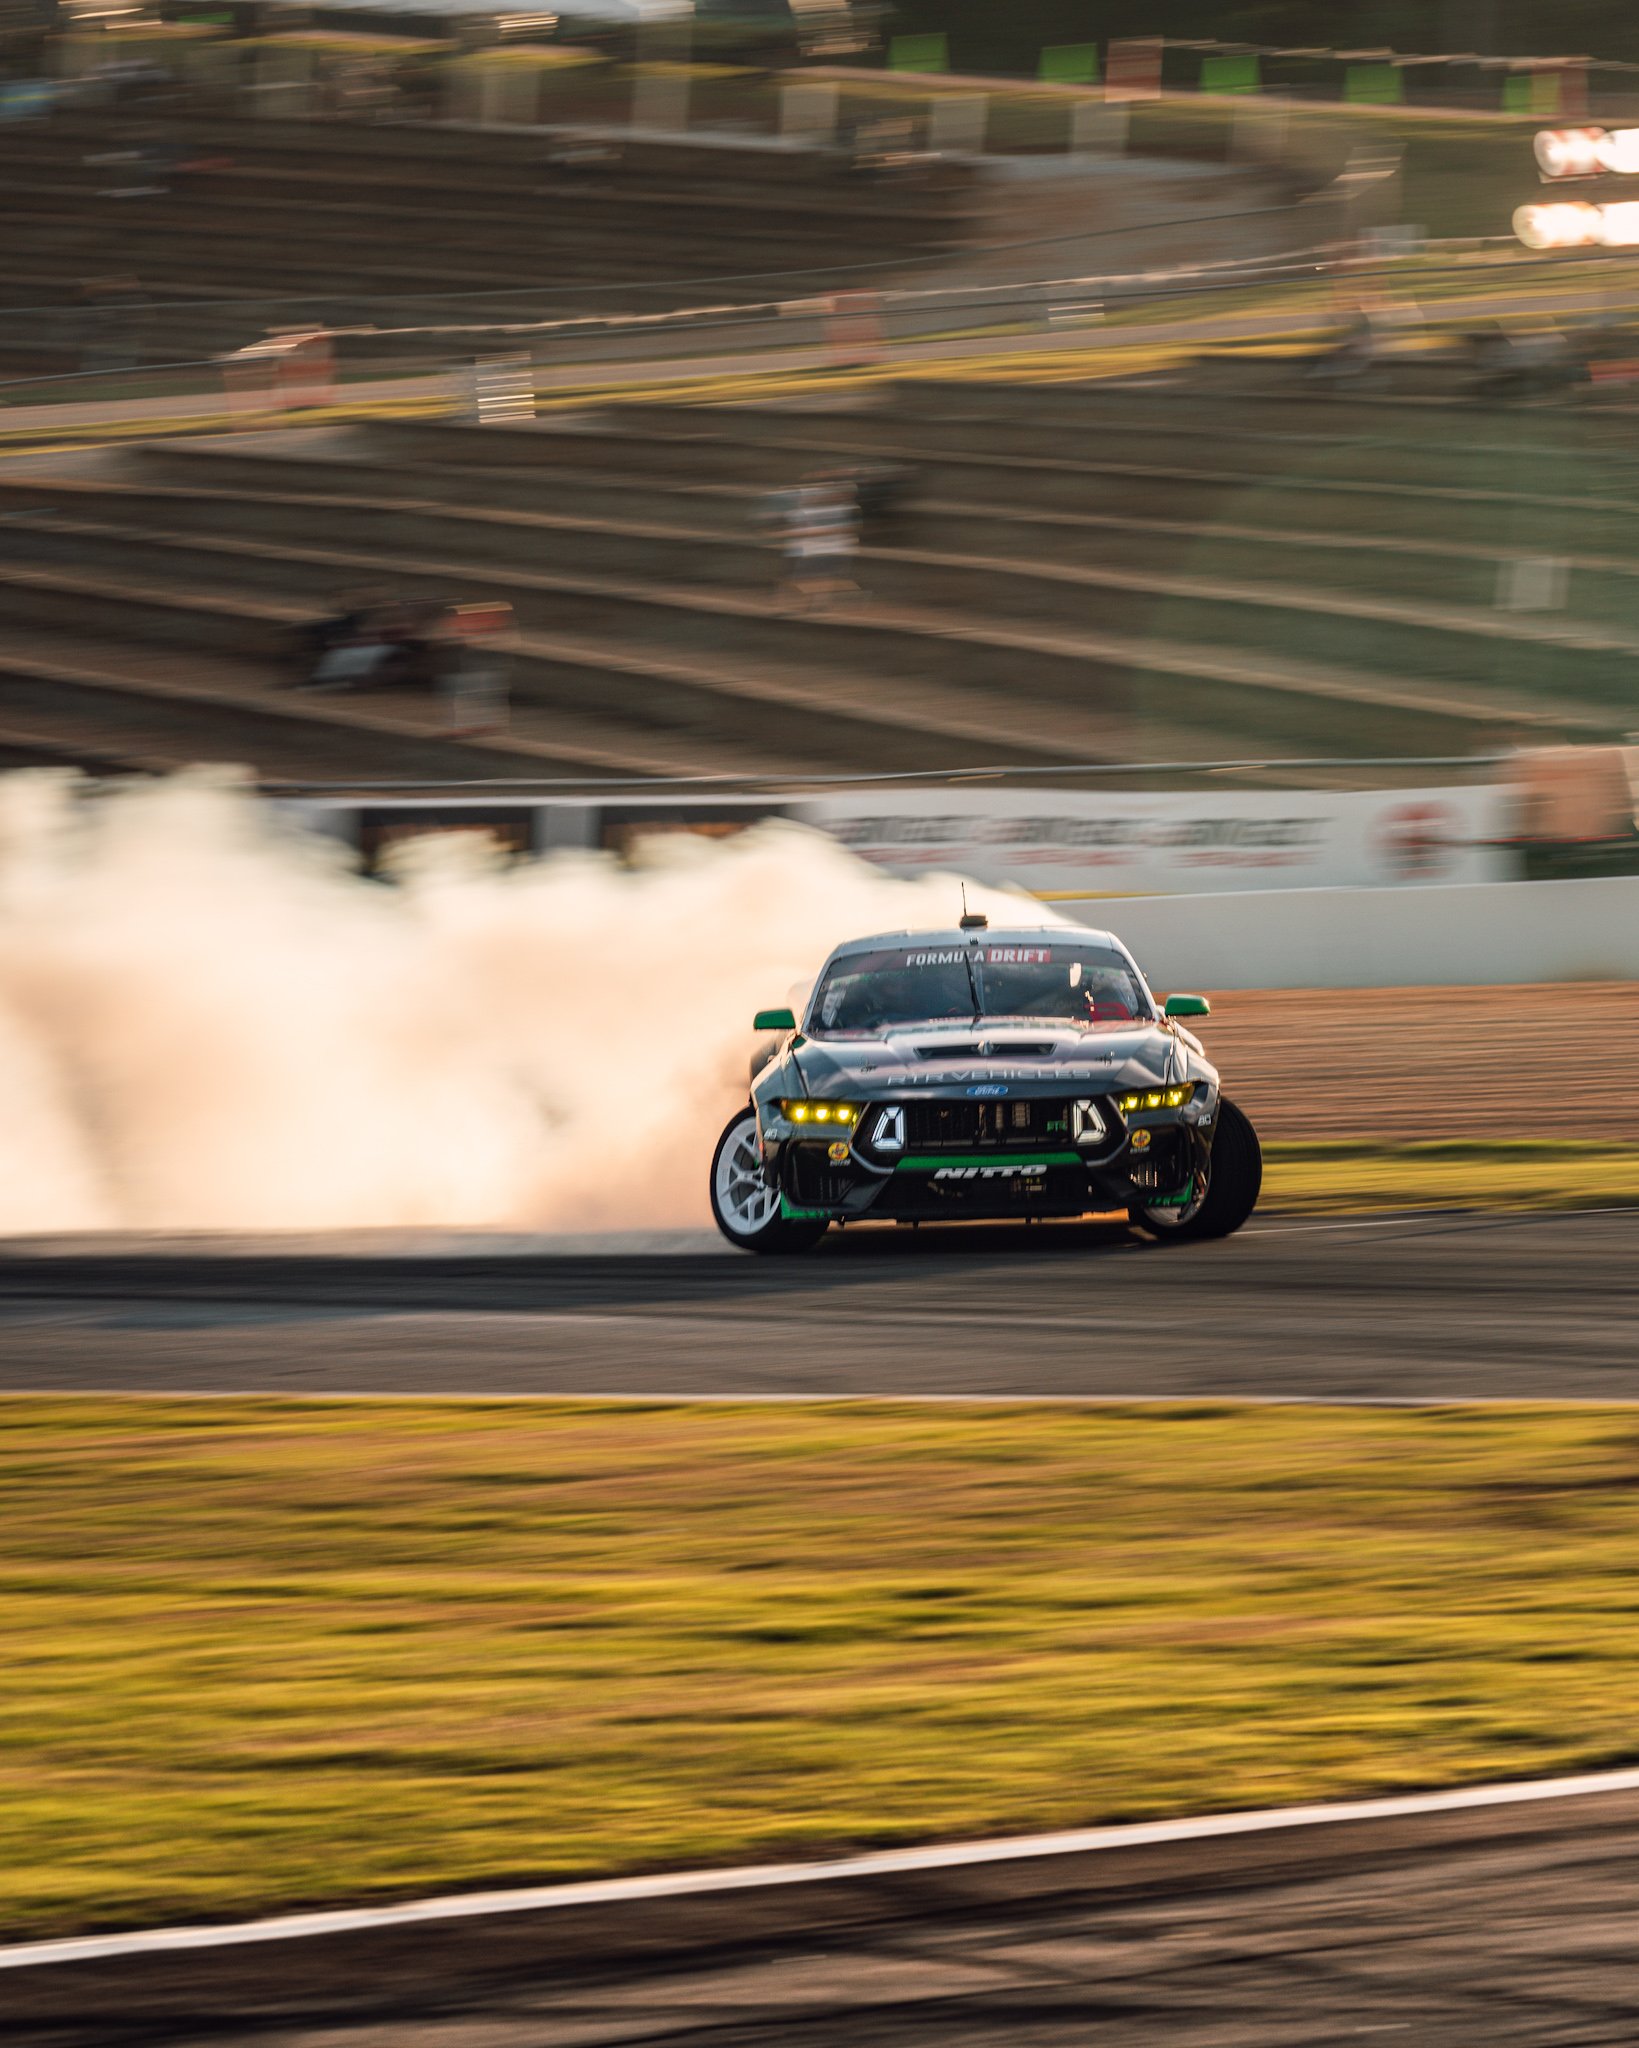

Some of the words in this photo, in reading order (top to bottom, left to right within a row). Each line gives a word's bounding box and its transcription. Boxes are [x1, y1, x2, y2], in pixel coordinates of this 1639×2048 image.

[906, 950, 984, 966] FORMULA
[990, 949, 1048, 962] DRIFT
[951, 1069, 1090, 1081] VEHICLES
[934, 1164, 1047, 1179] NITTO
